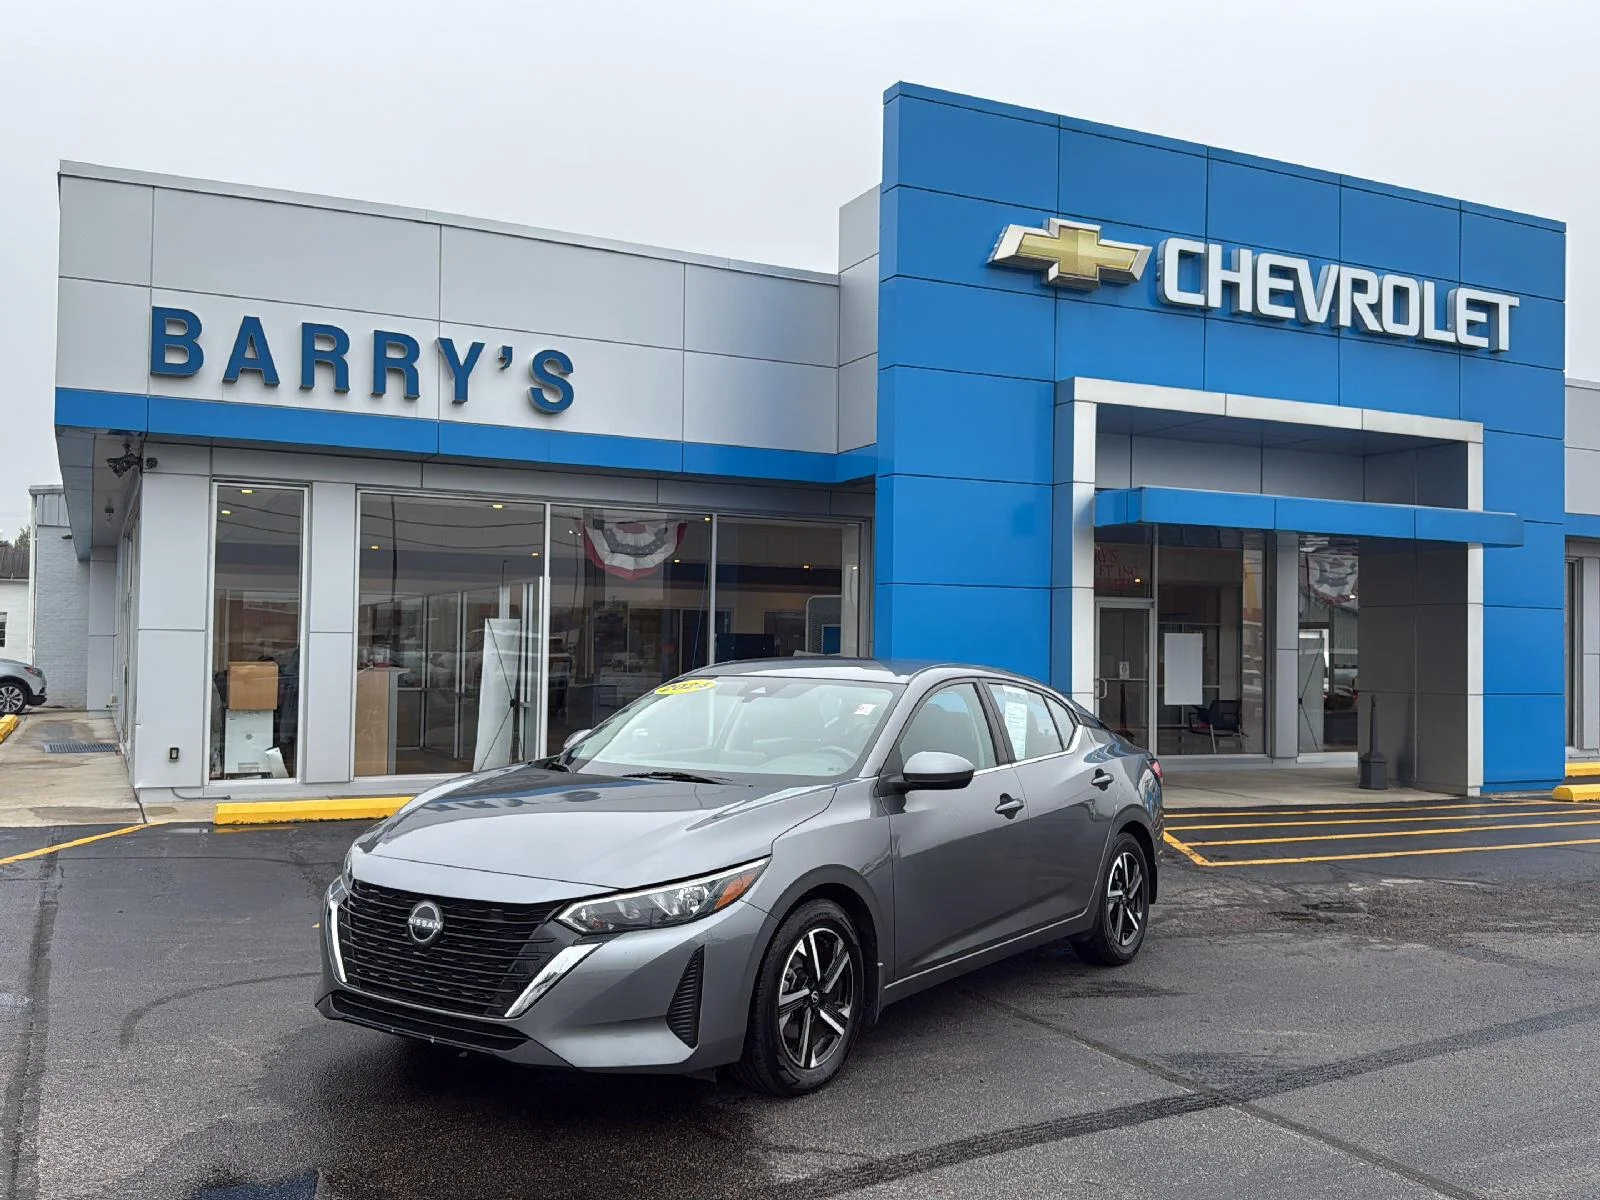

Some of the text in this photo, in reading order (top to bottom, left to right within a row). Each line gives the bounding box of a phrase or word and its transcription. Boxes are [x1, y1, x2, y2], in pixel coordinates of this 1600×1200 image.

[1157, 238, 1520, 353] CHEVROLET
[150, 305, 575, 415] BARRY'S
[408, 917, 441, 930] NISSAN
